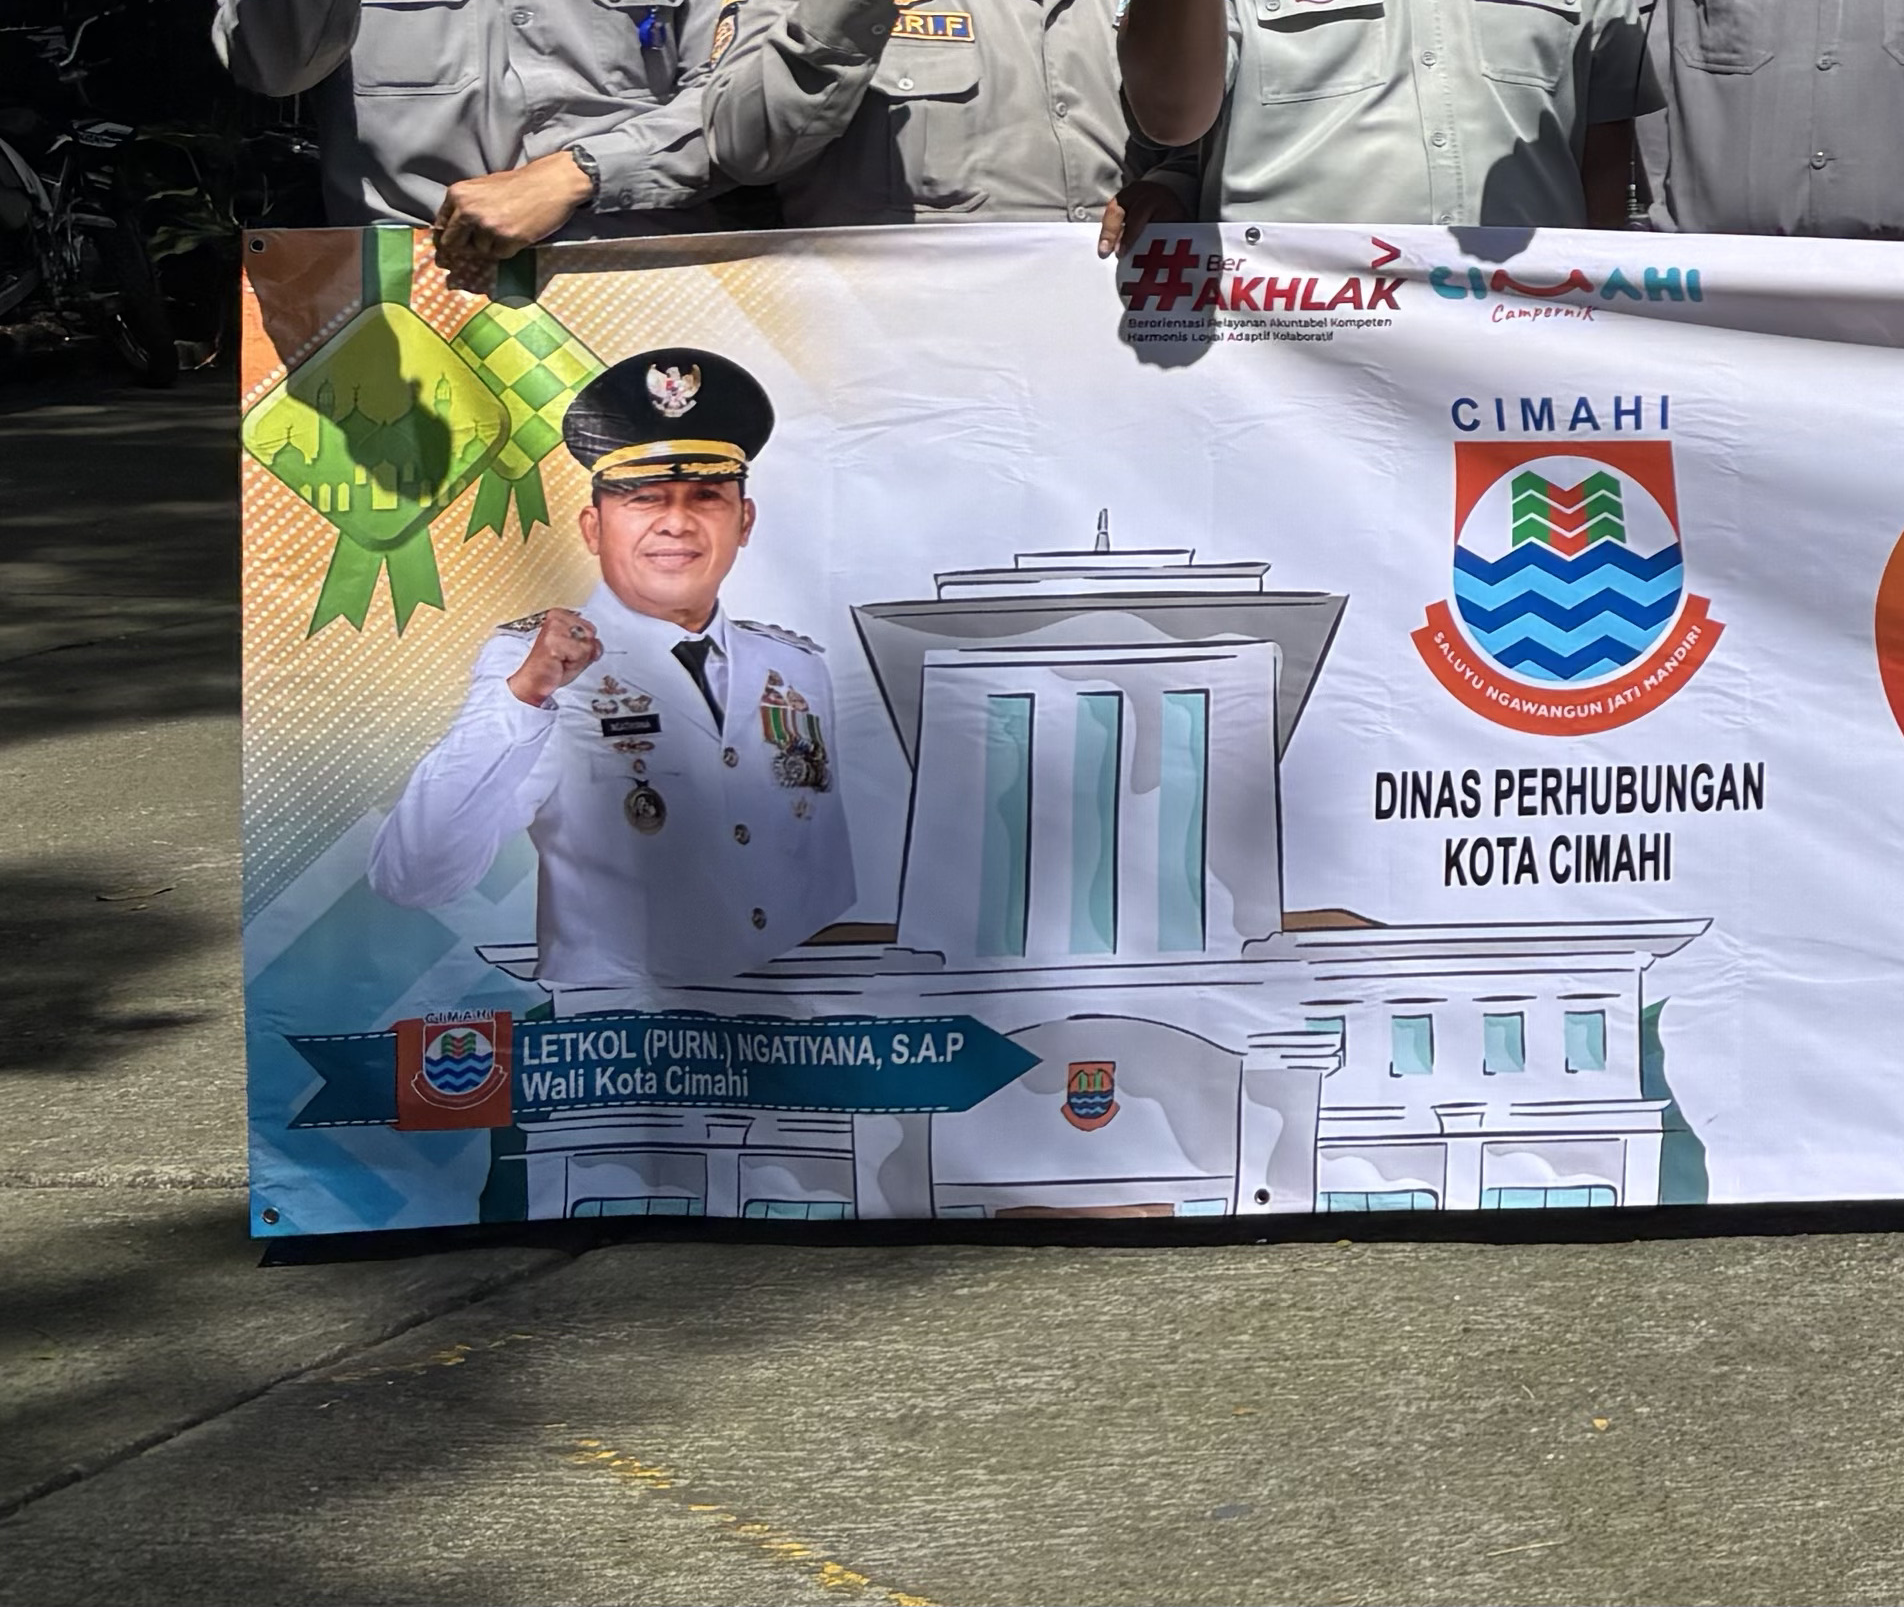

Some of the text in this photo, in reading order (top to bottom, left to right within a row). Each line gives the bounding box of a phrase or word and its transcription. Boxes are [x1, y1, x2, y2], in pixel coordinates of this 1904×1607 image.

[1205, 254, 1247, 273] Ber
[1191, 276, 1409, 312] AKHLAK
[1428, 265, 1704, 303] CIMAHI
[1127, 316, 1393, 332] Berorientasi Pelayanan Akuntabel Kompeten
[1491, 302, 1602, 325] Campernik
[1127, 330, 1334, 344] Harmonis Loyal Adaptif Kolaboratif
[1450, 394, 1671, 433] CIMAHI
[1433, 624, 1703, 719] SALUYU NGAWANGUN JATI MANDIRI
[1374, 760, 1766, 821] DINAS PERHUBUNGAN
[1443, 832, 1672, 887] KOTA CIMAHI
[522, 1028, 966, 1071] LETKOL (PURN.) NGATIYANA, S.A.P
[522, 1066, 750, 1102] Wali Kota Cimahi
